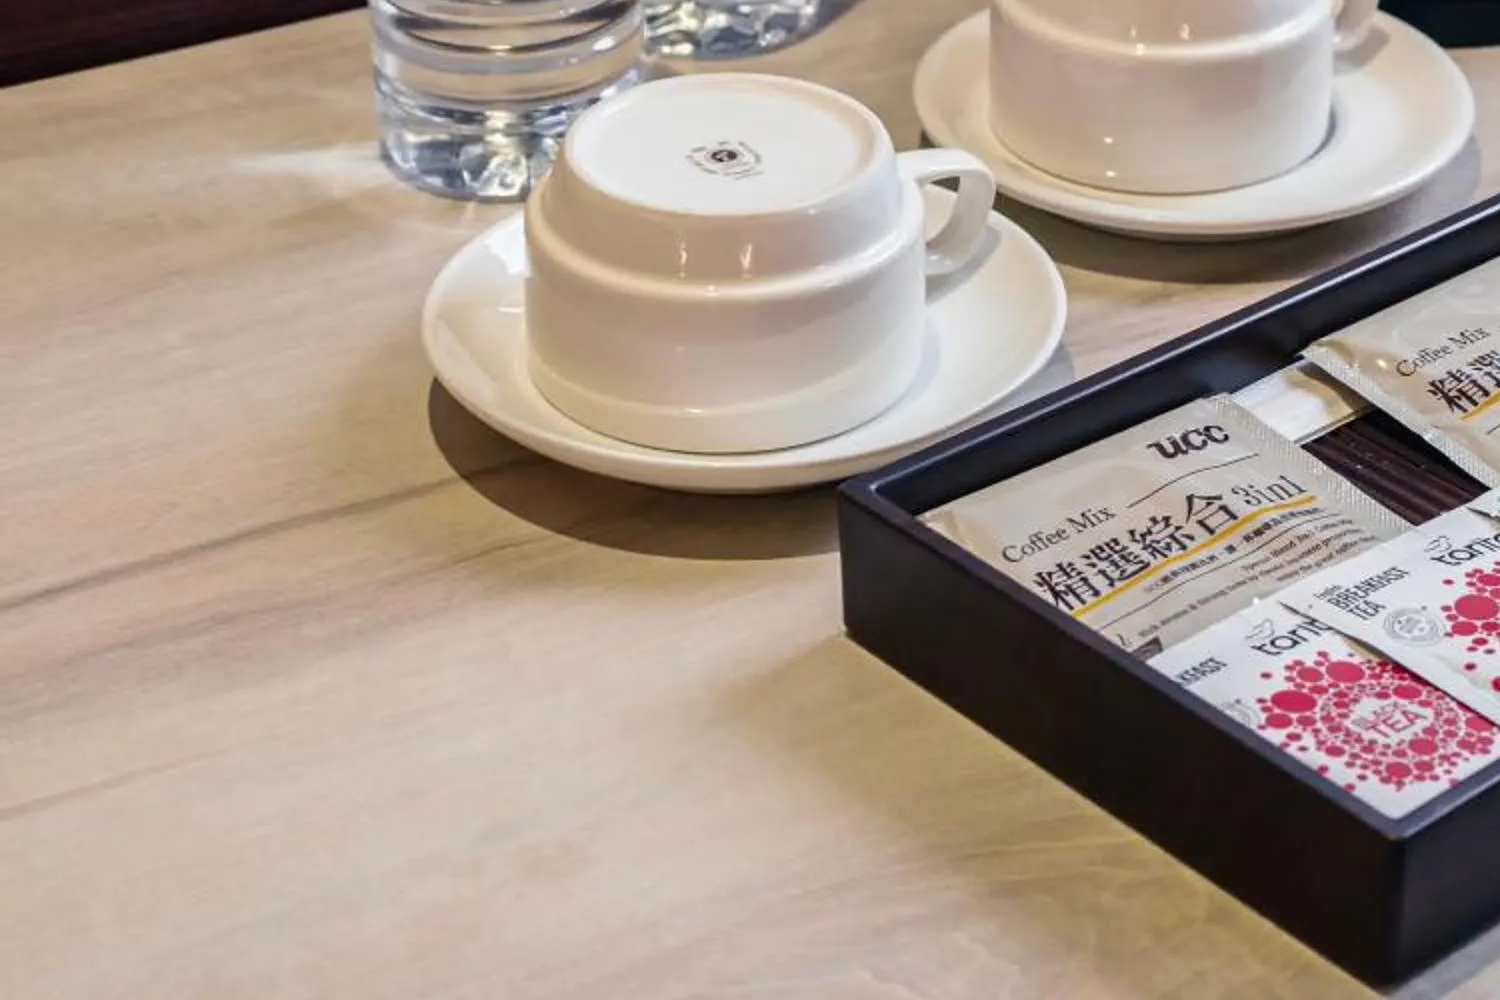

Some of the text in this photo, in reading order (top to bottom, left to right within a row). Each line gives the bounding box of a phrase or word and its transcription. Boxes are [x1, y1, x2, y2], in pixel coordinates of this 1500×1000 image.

[1396, 326, 1493, 378] Coffee Mix
[1002, 504, 1119, 565] Coffee Mix
[1033, 493, 1239, 612] 精選綜合
[1230, 475, 1308, 507] 3in1
[1327, 566, 1409, 610] BREAKFAST
[1346, 599, 1387, 620] TEA
[1365, 709, 1428, 739] TEA
